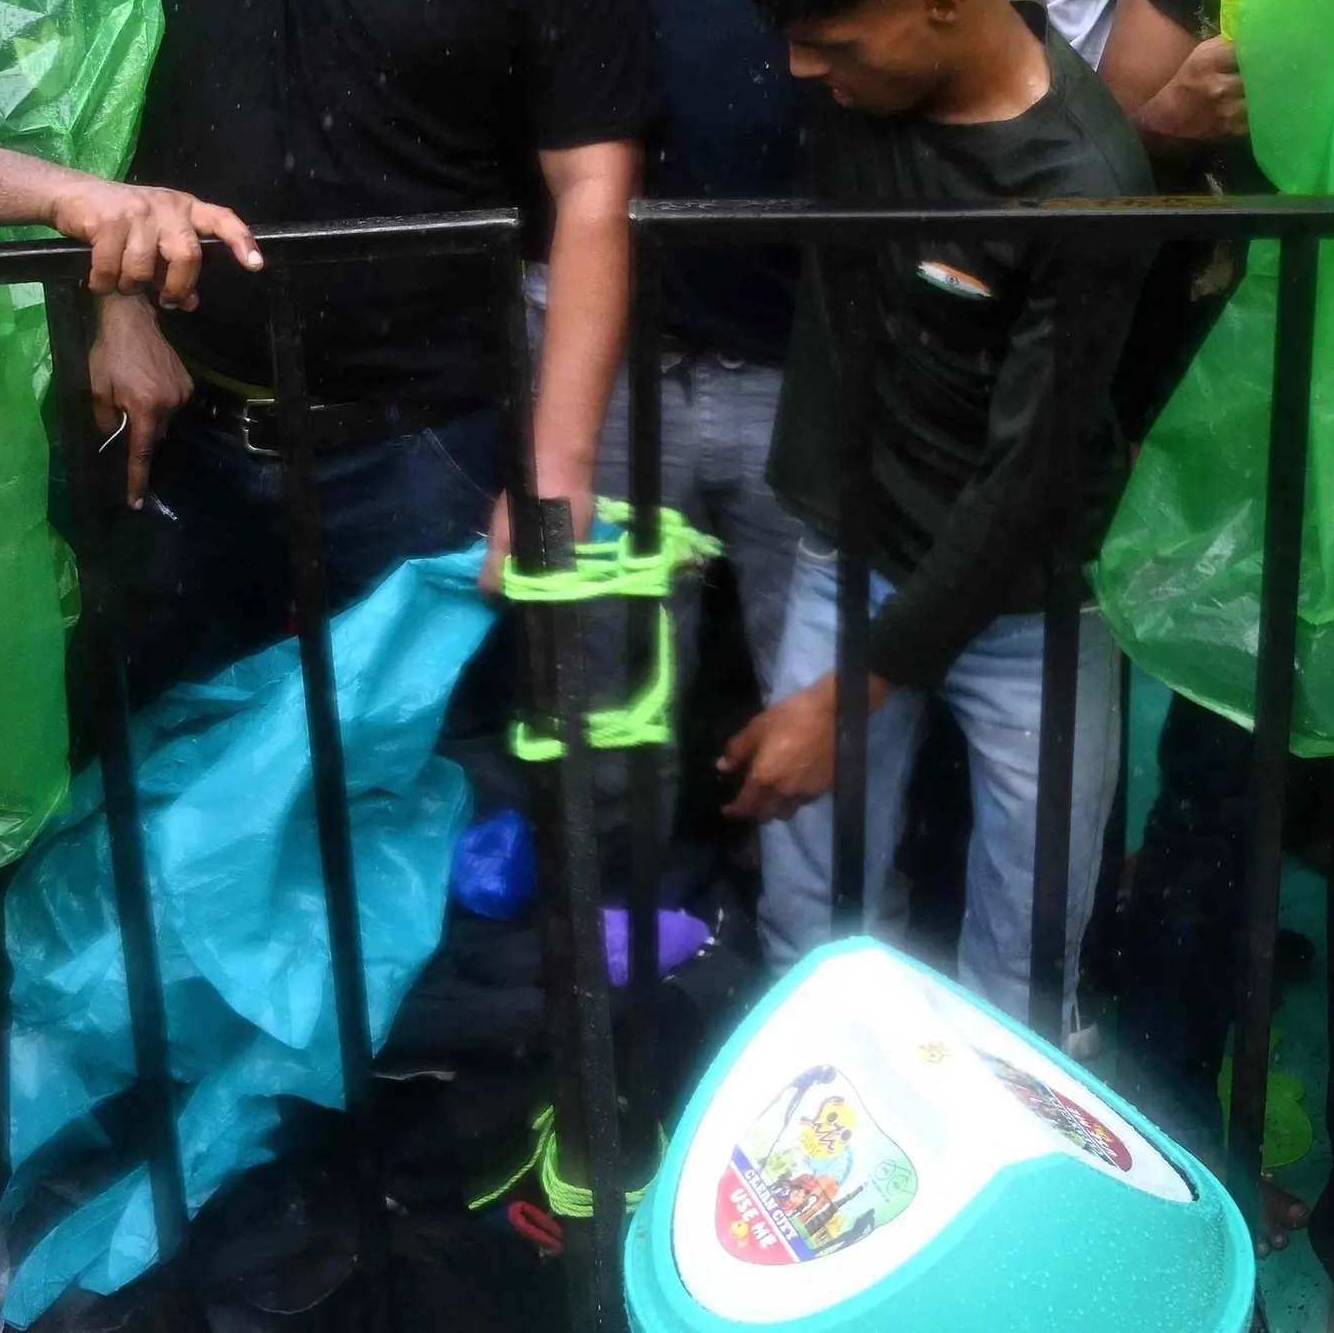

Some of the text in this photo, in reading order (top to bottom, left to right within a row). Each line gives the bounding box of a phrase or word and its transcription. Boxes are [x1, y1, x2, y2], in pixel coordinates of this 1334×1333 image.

[730, 1188, 777, 1249] USE ME
[772, 1210, 798, 1240] CITY
